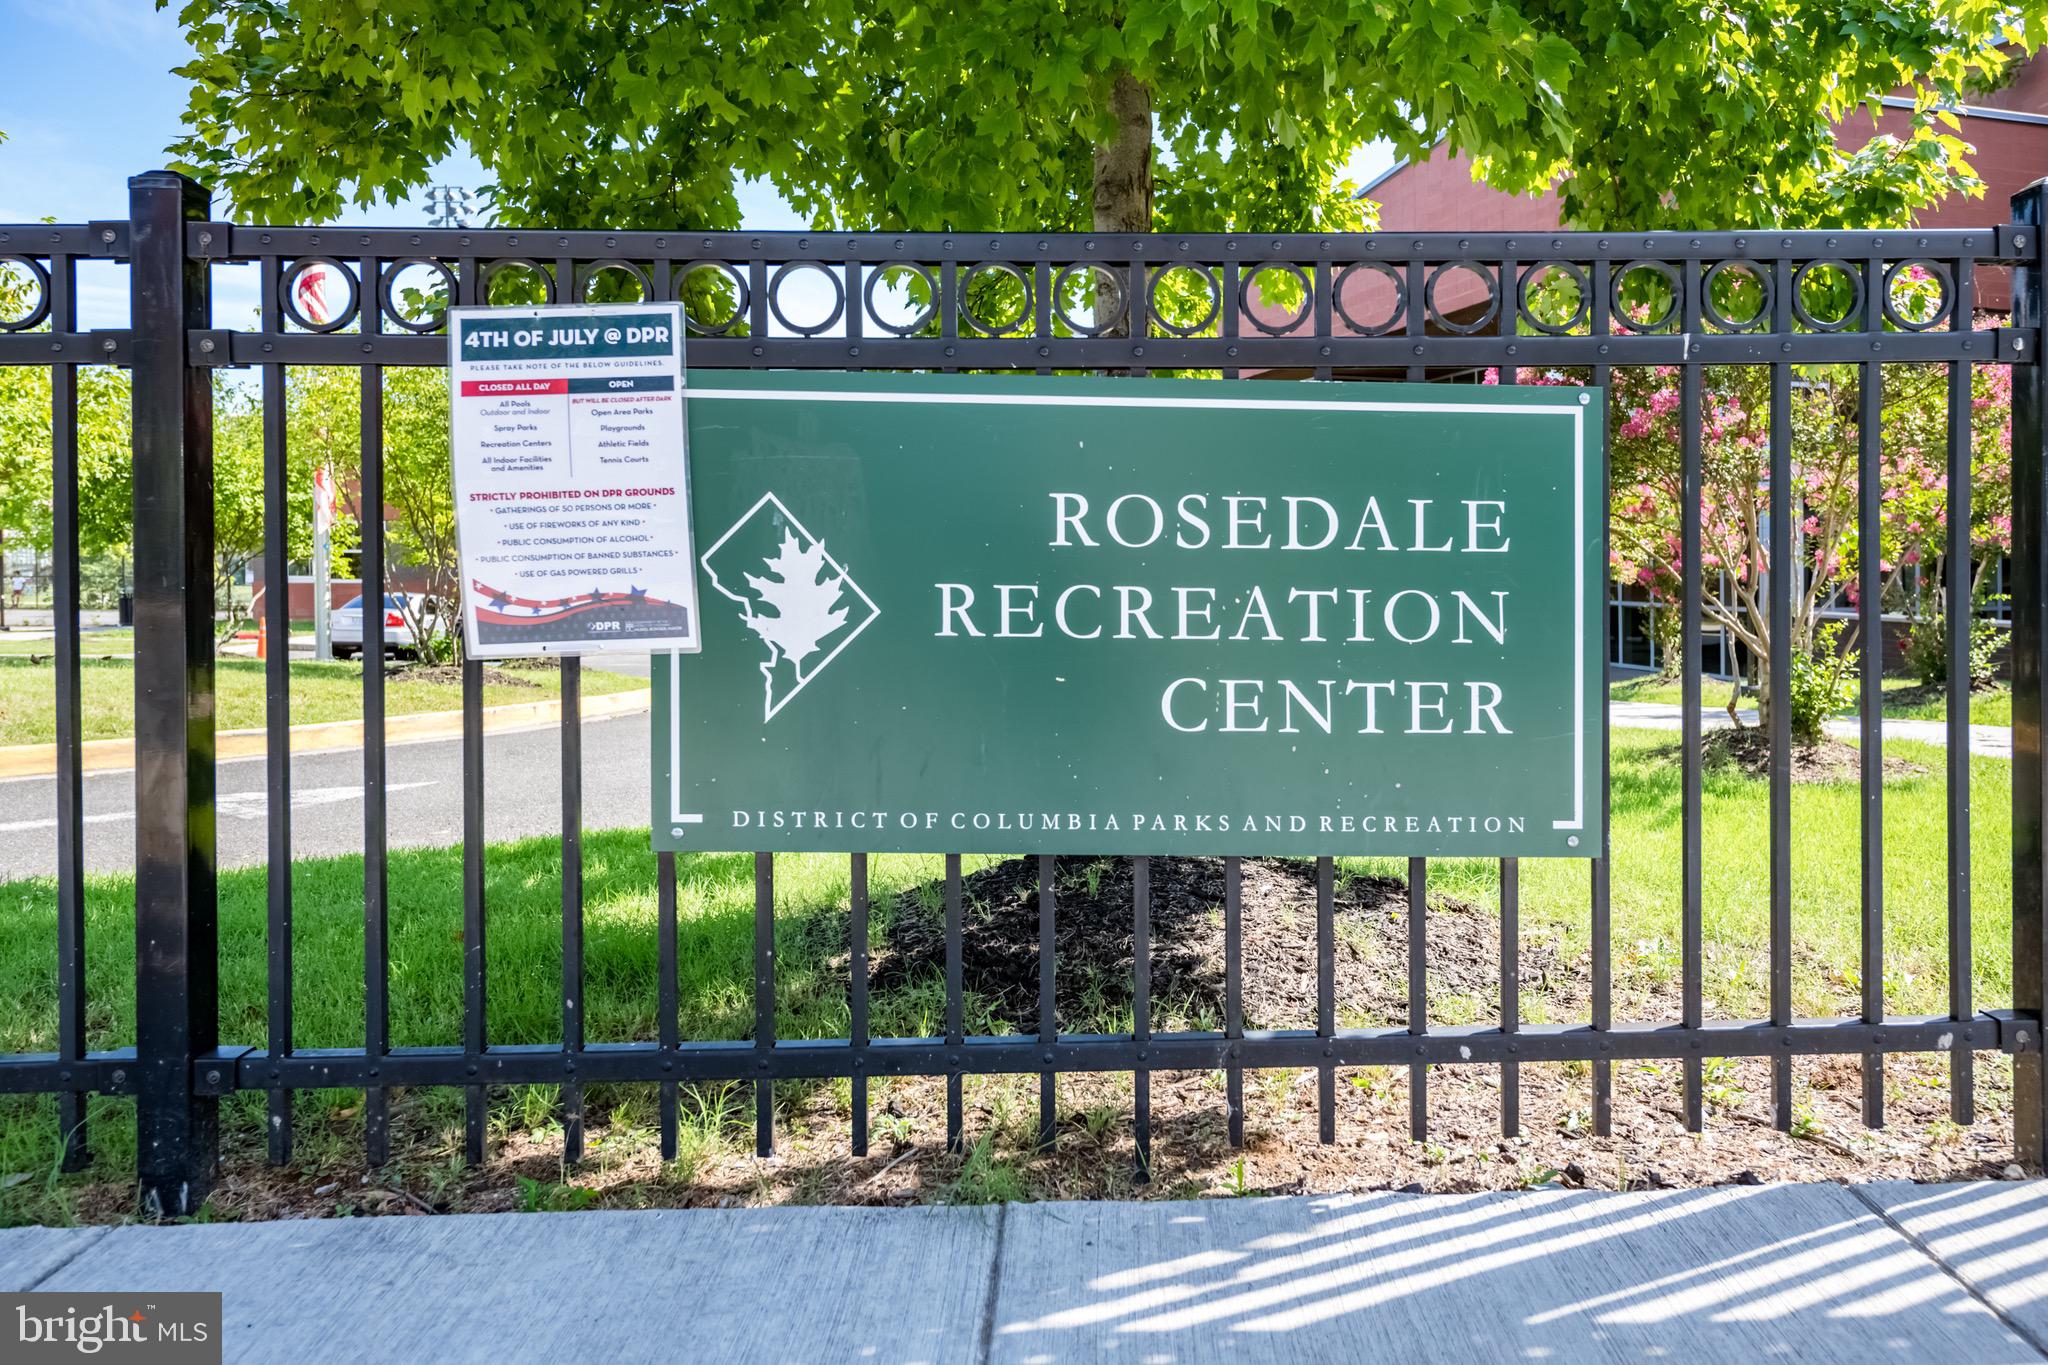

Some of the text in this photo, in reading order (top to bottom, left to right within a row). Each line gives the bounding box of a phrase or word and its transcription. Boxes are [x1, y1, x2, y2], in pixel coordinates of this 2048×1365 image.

[464, 326, 669, 347] 4TH OF JULY @ DPR
[515, 383, 532, 391] ALL
[533, 382, 551, 390] DAY
[608, 380, 634, 388] OPEN
[591, 409, 612, 417] Open
[600, 424, 645, 432] Playgrounds
[628, 439, 649, 447] Fields
[600, 455, 649, 464] Tennis Courts
[470, 487, 675, 501] STRICTLY PROHIBITED ON DPR GROUNDS
[495, 506, 546, 514] GATHERINGS
[548, 505, 560, 513] OF
[628, 502, 651, 510] MORE
[509, 522, 524, 530] USE
[540, 521, 586, 529] FIREWORKS
[1049, 493, 1510, 552] ROSEDALE
[502, 538, 532, 546] PUBLIC
[533, 537, 594, 545] CONSUMPTION
[480, 555, 509, 563] PUBLIC
[512, 554, 572, 562] CONSUMPTION
[623, 550, 674, 558] SUBSTANCES
[935, 584, 1509, 645] RECREATION
[596, 621, 621, 631] DPR
[1161, 678, 1513, 734] CENTER
[732, 811, 1526, 833] DISTRICT OF COLUMBIA PARKS AND RECREATION
